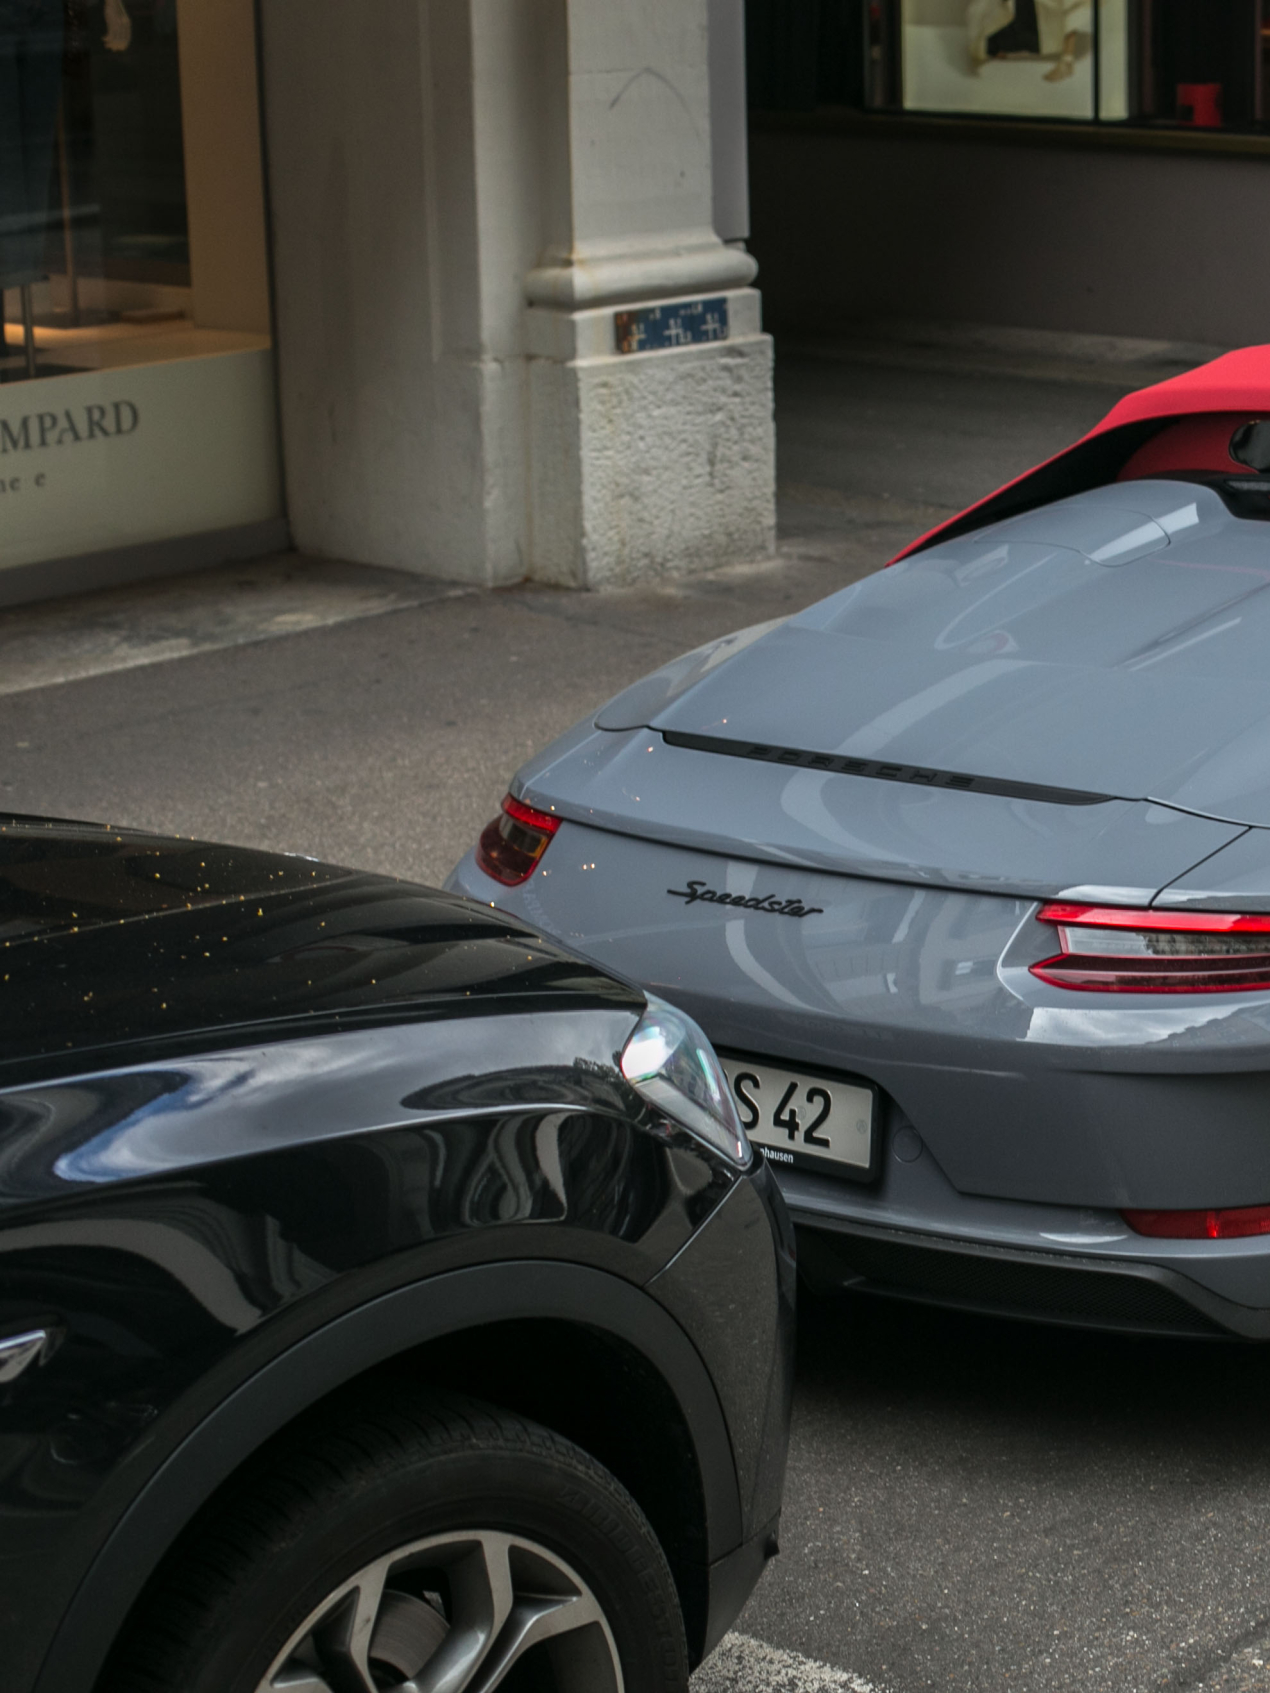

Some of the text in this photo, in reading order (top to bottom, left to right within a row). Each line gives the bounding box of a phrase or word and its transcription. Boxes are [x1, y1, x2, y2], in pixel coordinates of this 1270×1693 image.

[0, 400, 140, 454] MPARD
[747, 745, 975, 788] PORSCHE
[666, 880, 824, 918] Speedster
[772, 1081, 832, 1149] 42
